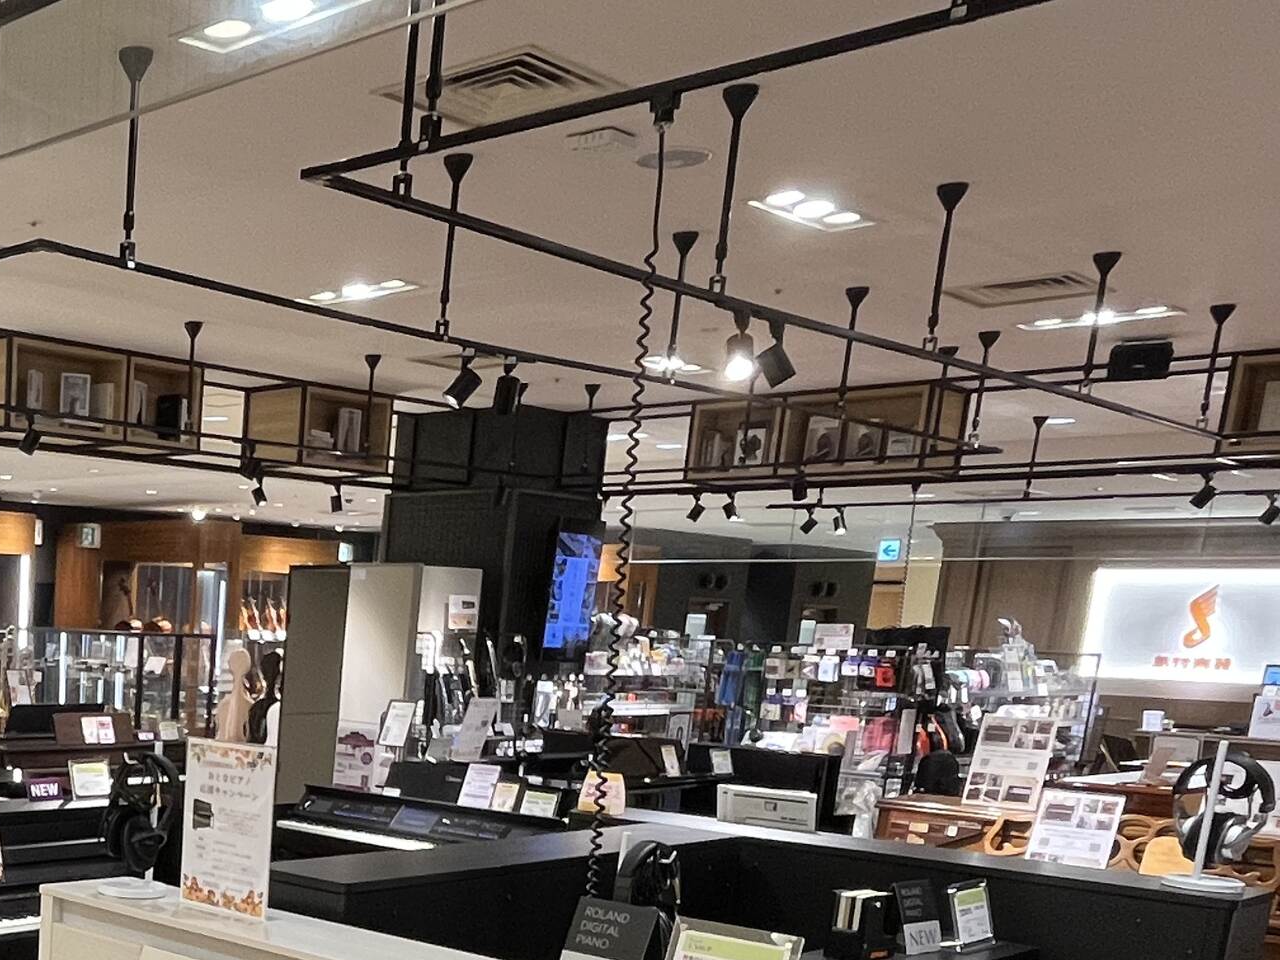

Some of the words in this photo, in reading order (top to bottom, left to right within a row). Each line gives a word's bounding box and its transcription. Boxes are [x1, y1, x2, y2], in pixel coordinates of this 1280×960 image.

[30, 782, 59, 797] NEW
[584, 906, 631, 924] ROLAND
[579, 919, 620, 937] DIGITAL
[909, 928, 938, 946] NEW
[575, 935, 610, 950] PIANO
